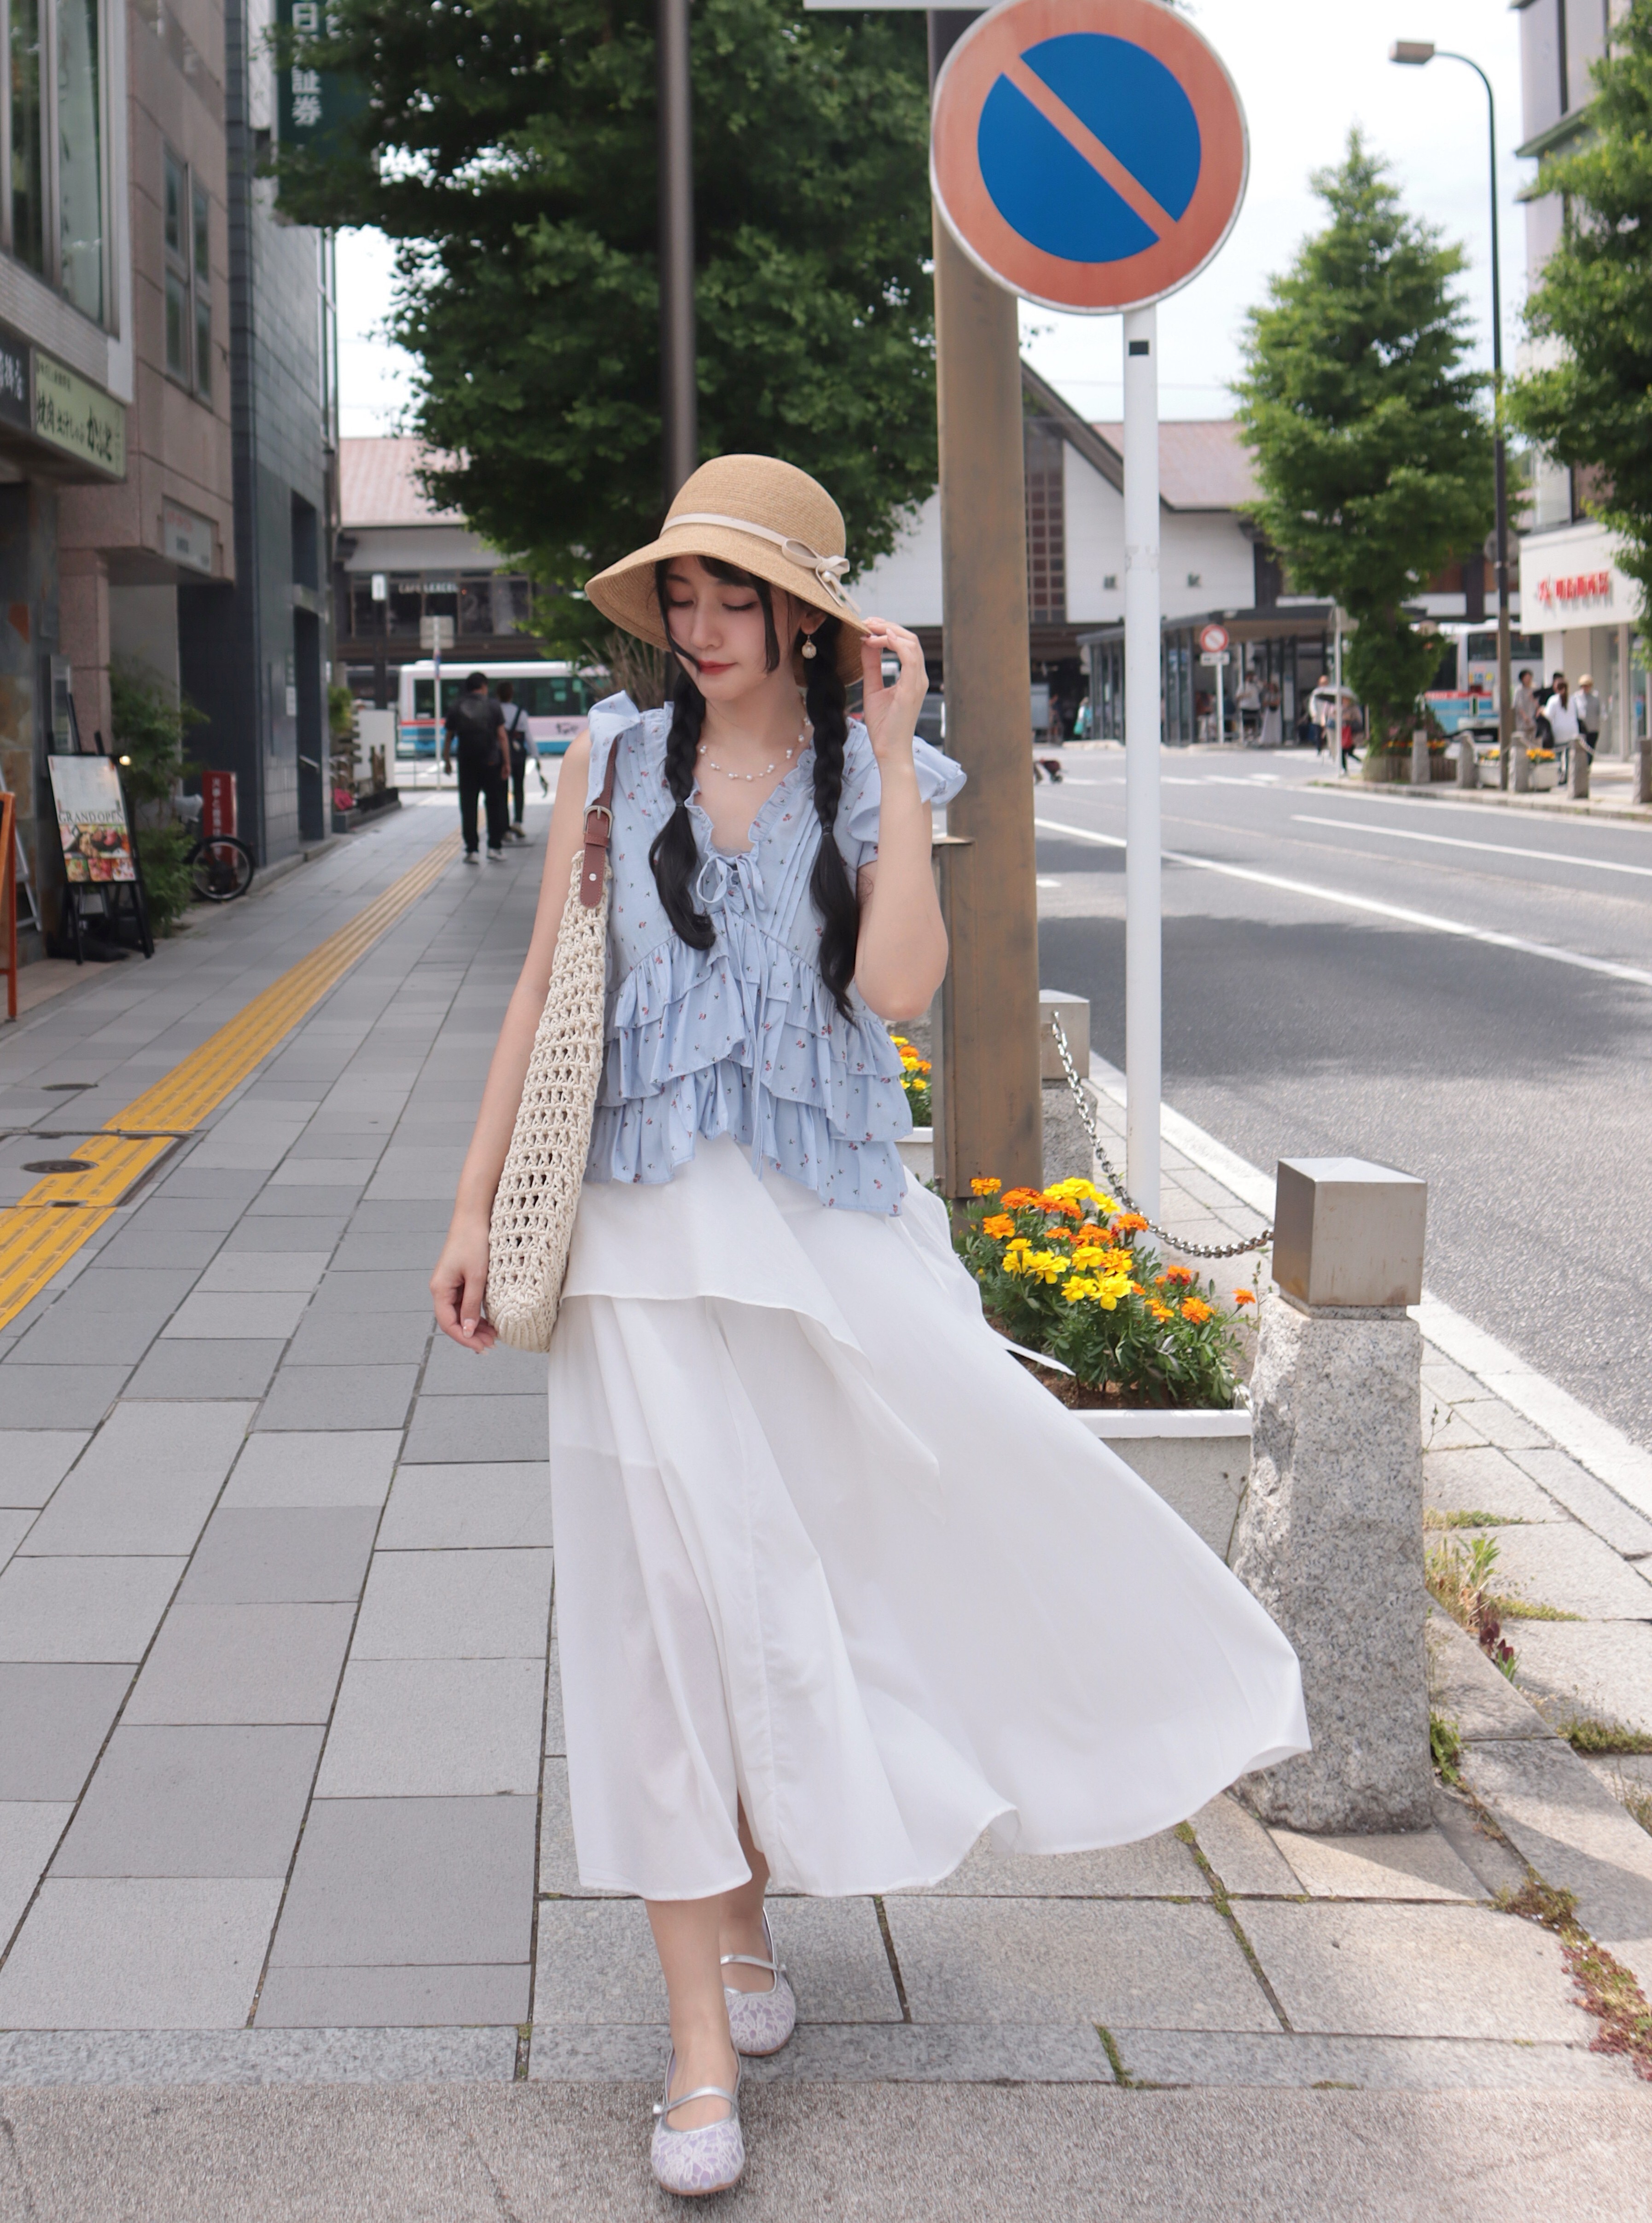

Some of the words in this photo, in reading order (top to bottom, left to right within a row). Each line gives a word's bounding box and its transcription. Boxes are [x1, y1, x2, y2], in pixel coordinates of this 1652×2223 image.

[292, 2, 321, 126] 日証券
[58, 811, 96, 823] GRAND
[97, 811, 124, 822] OPEN
